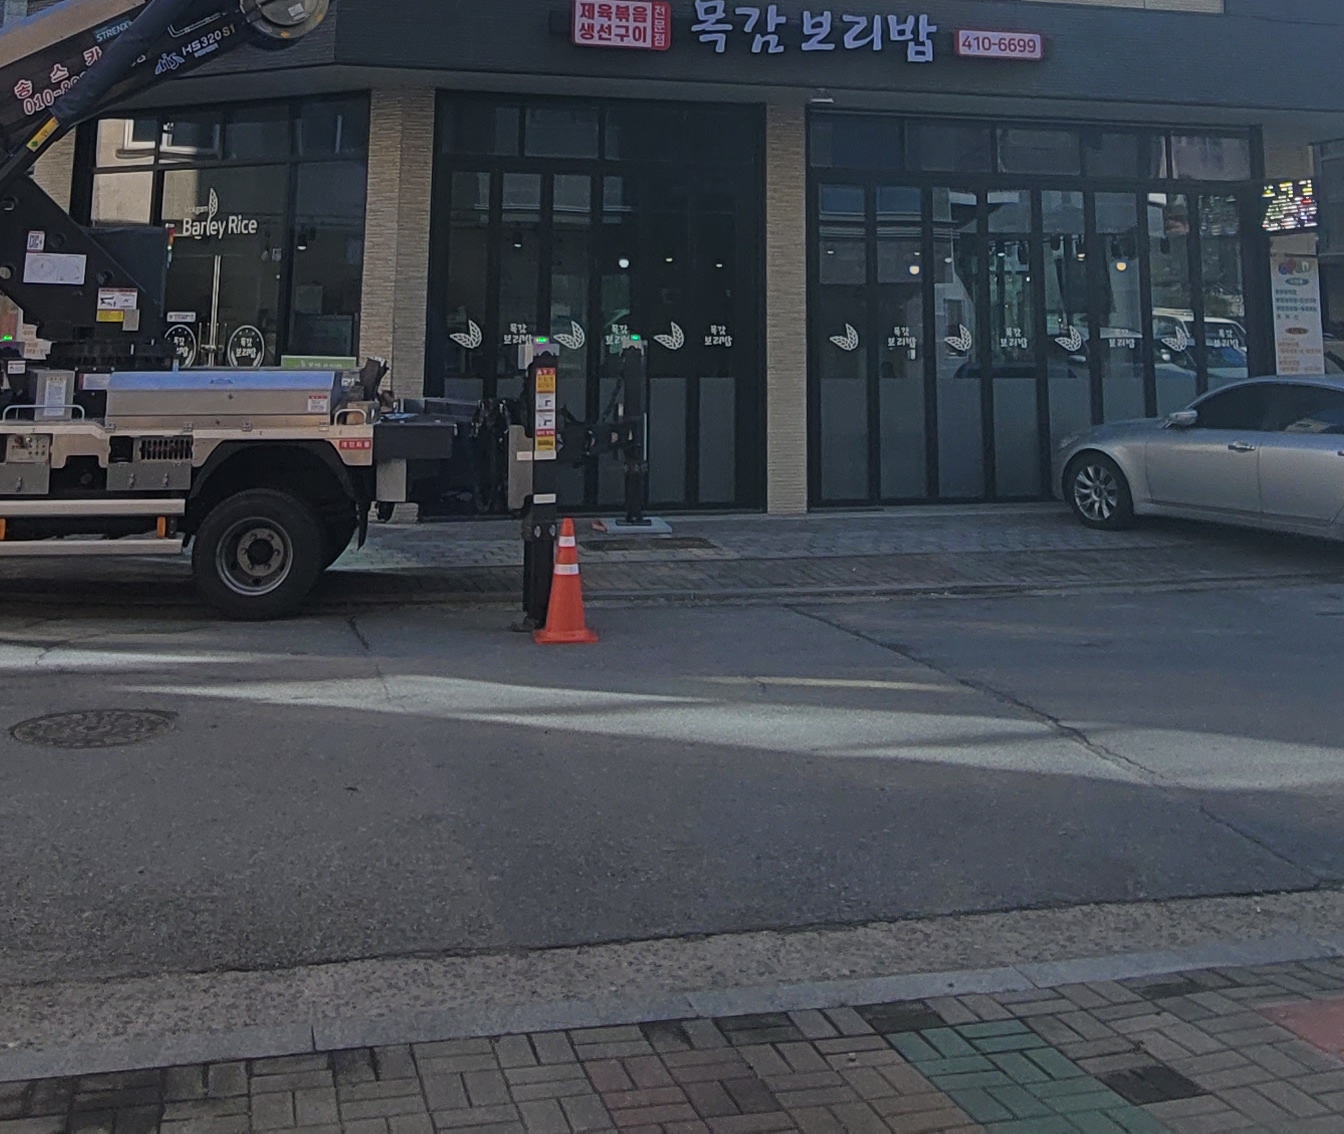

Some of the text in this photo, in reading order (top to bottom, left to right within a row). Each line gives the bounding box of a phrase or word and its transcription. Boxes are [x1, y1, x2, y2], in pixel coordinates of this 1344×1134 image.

[579, 2, 648, 23] 제육볶음
[579, 22, 647, 43] 생선구이
[654, 5, 666, 46] 전문점
[801, 10, 938, 63] 보리밥
[961, 34, 1038, 54] 410-6699
[182, 214, 258, 240] Barley Rice
